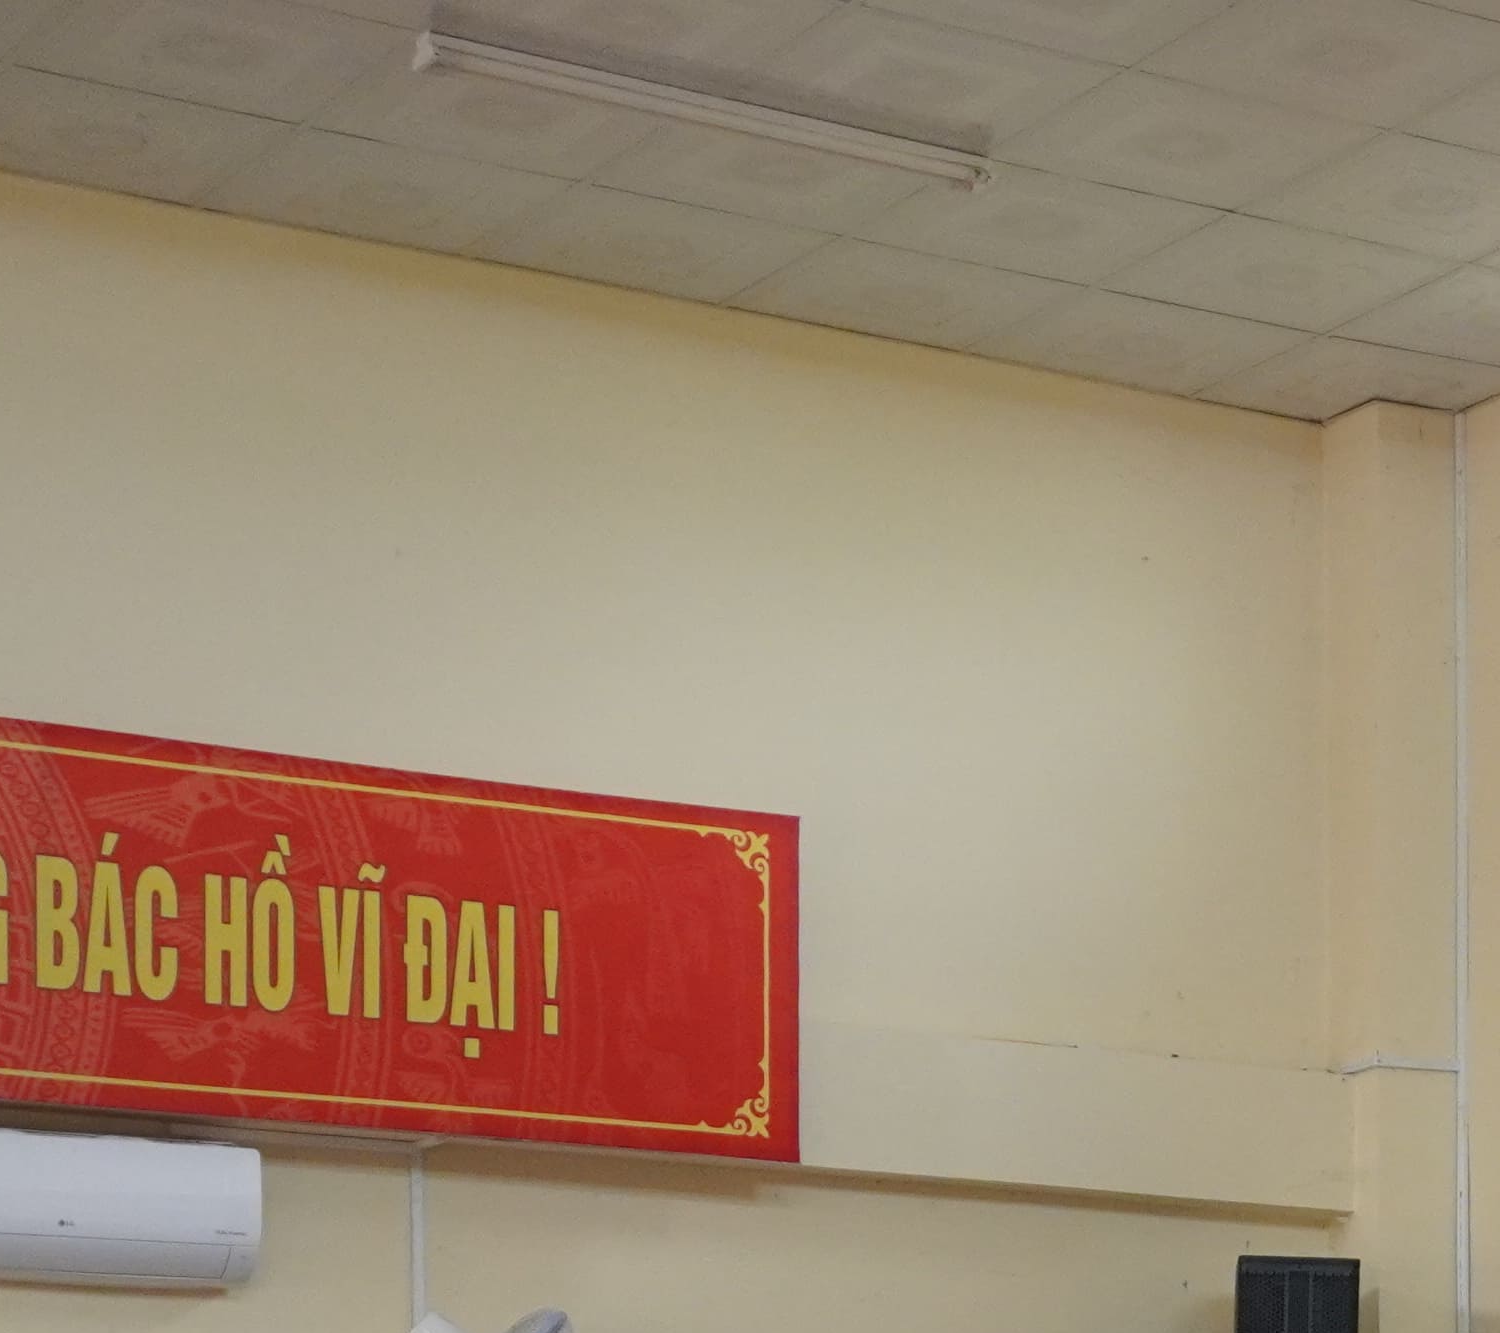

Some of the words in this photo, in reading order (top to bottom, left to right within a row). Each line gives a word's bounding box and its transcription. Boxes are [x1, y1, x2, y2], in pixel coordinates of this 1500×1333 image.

[36, 832, 179, 1001] BÁC
[205, 834, 295, 1012] HỒ
[318, 863, 387, 1019] VĨ
